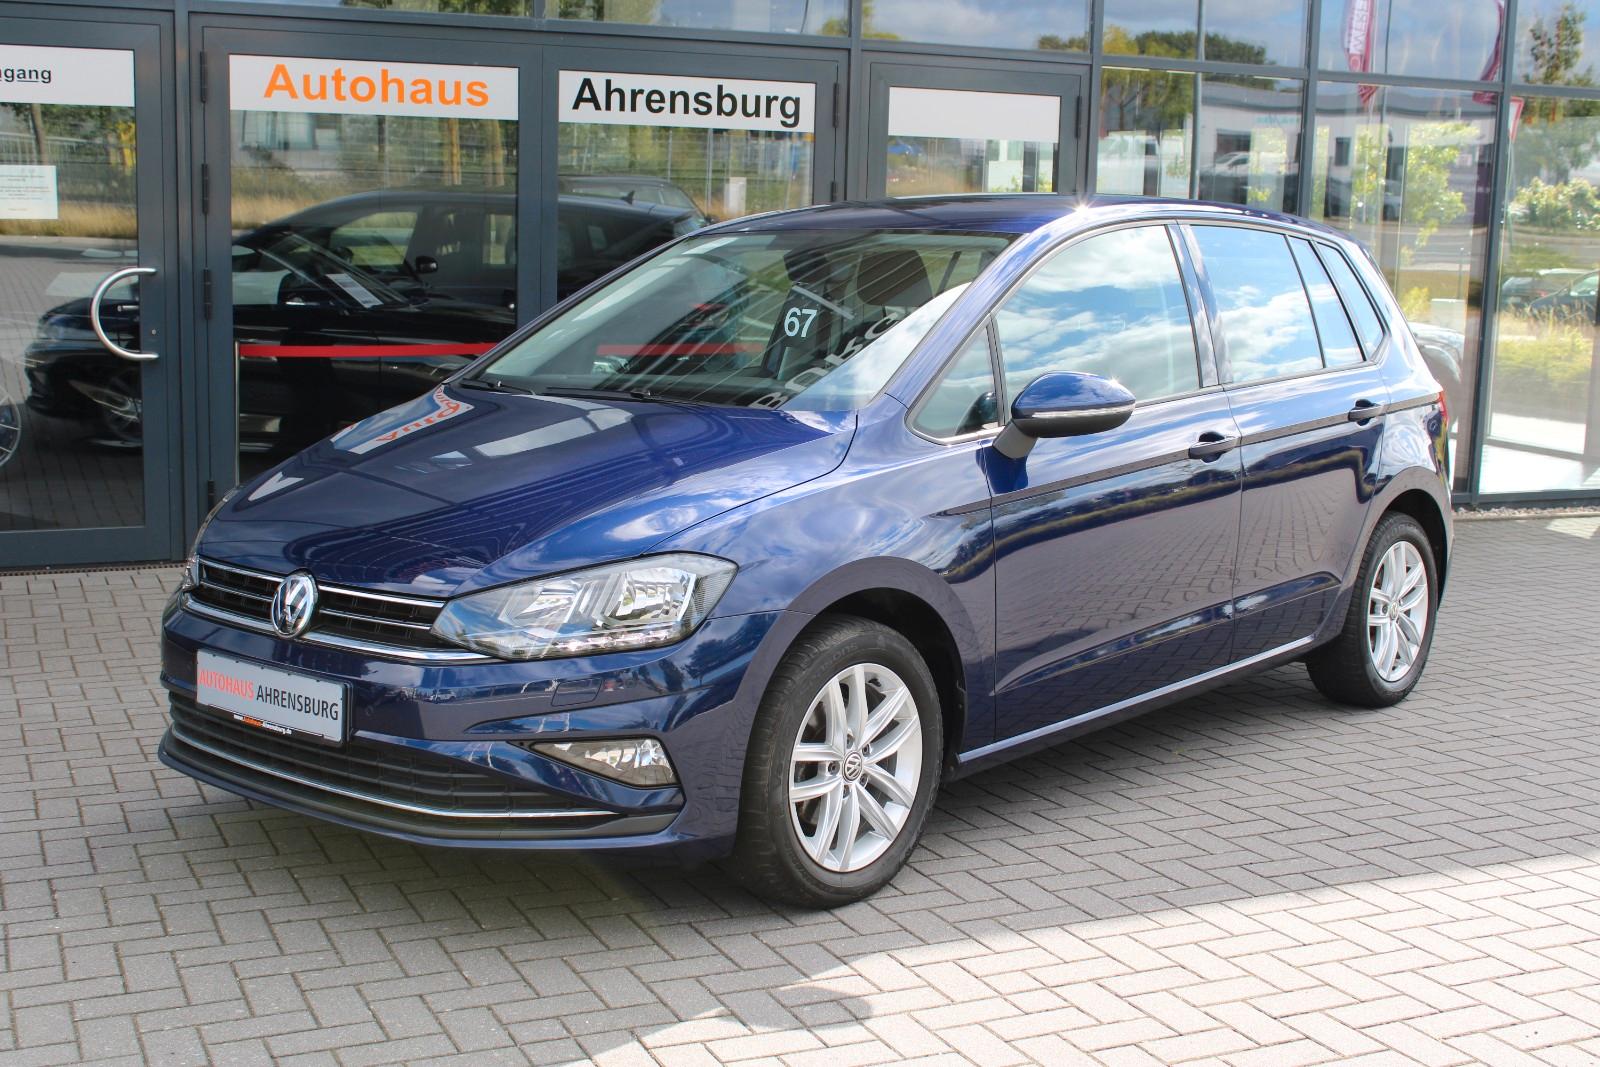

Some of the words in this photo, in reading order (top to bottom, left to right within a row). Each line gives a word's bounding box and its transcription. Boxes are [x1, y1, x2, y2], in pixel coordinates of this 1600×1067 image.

[0, 68, 52, 84] gang
[263, 63, 490, 107] Autohaus
[572, 77, 801, 128] Ahrensburg
[784, 306, 818, 338] 67
[199, 669, 255, 700] AUTOHAUS
[256, 684, 340, 721] AHRENSBURG
